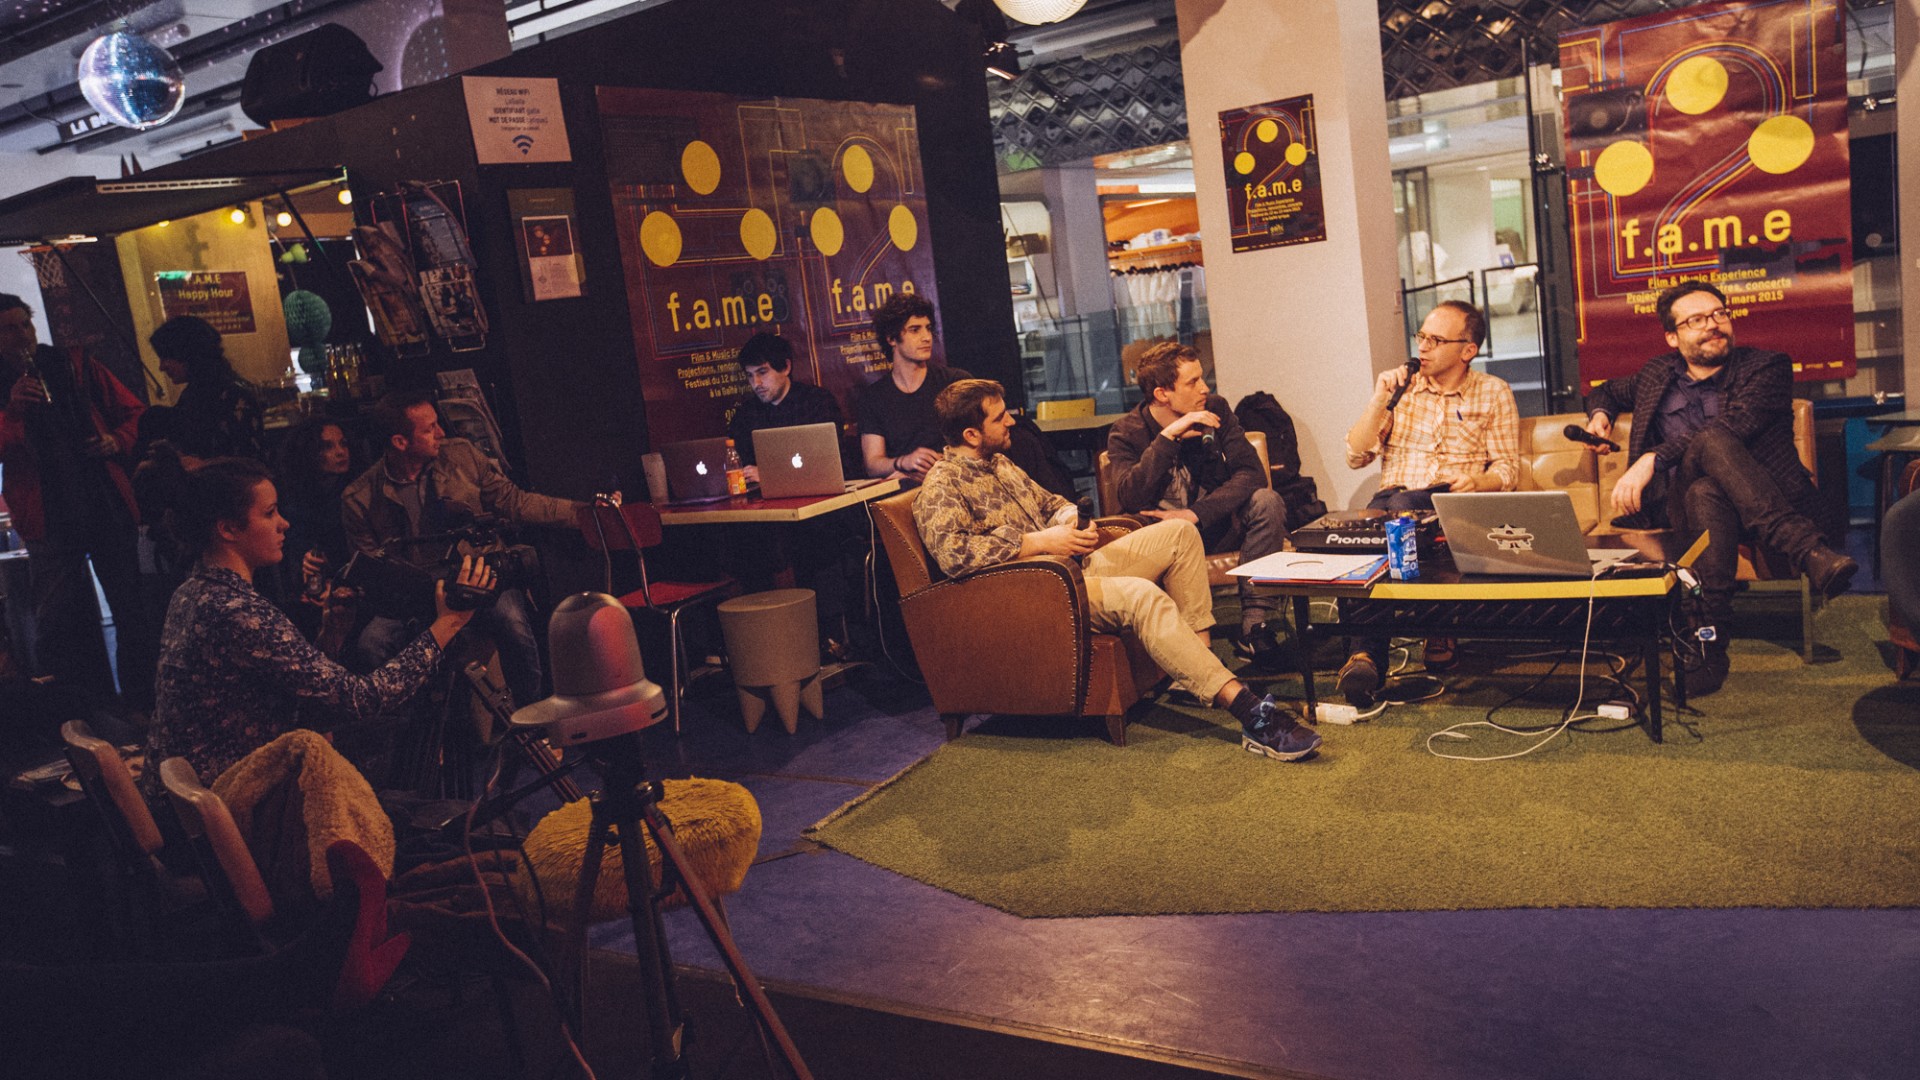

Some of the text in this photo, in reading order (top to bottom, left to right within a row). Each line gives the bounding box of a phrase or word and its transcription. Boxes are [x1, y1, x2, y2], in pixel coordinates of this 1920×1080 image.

[1244, 179, 1303, 200] f.a.m.e
[1621, 209, 1792, 260] f.a.m.e
[1648, 275, 1669, 290] Film
[1669, 275, 1679, 287] &
[1709, 267, 1767, 283] Experience
[1745, 277, 1792, 292] concerts
[178, 287, 234, 300] Happy Hour
[1731, 294, 1757, 305] mars
[1758, 289, 1784, 302] 2015
[667, 291, 774, 332] f.a.m.e
[691, 353, 705, 364] Film
[711, 350, 731, 360] Music
[684, 378, 711, 390] Festival
[721, 374, 730, 384] 12
[1326, 533, 1387, 545] Pioneer
